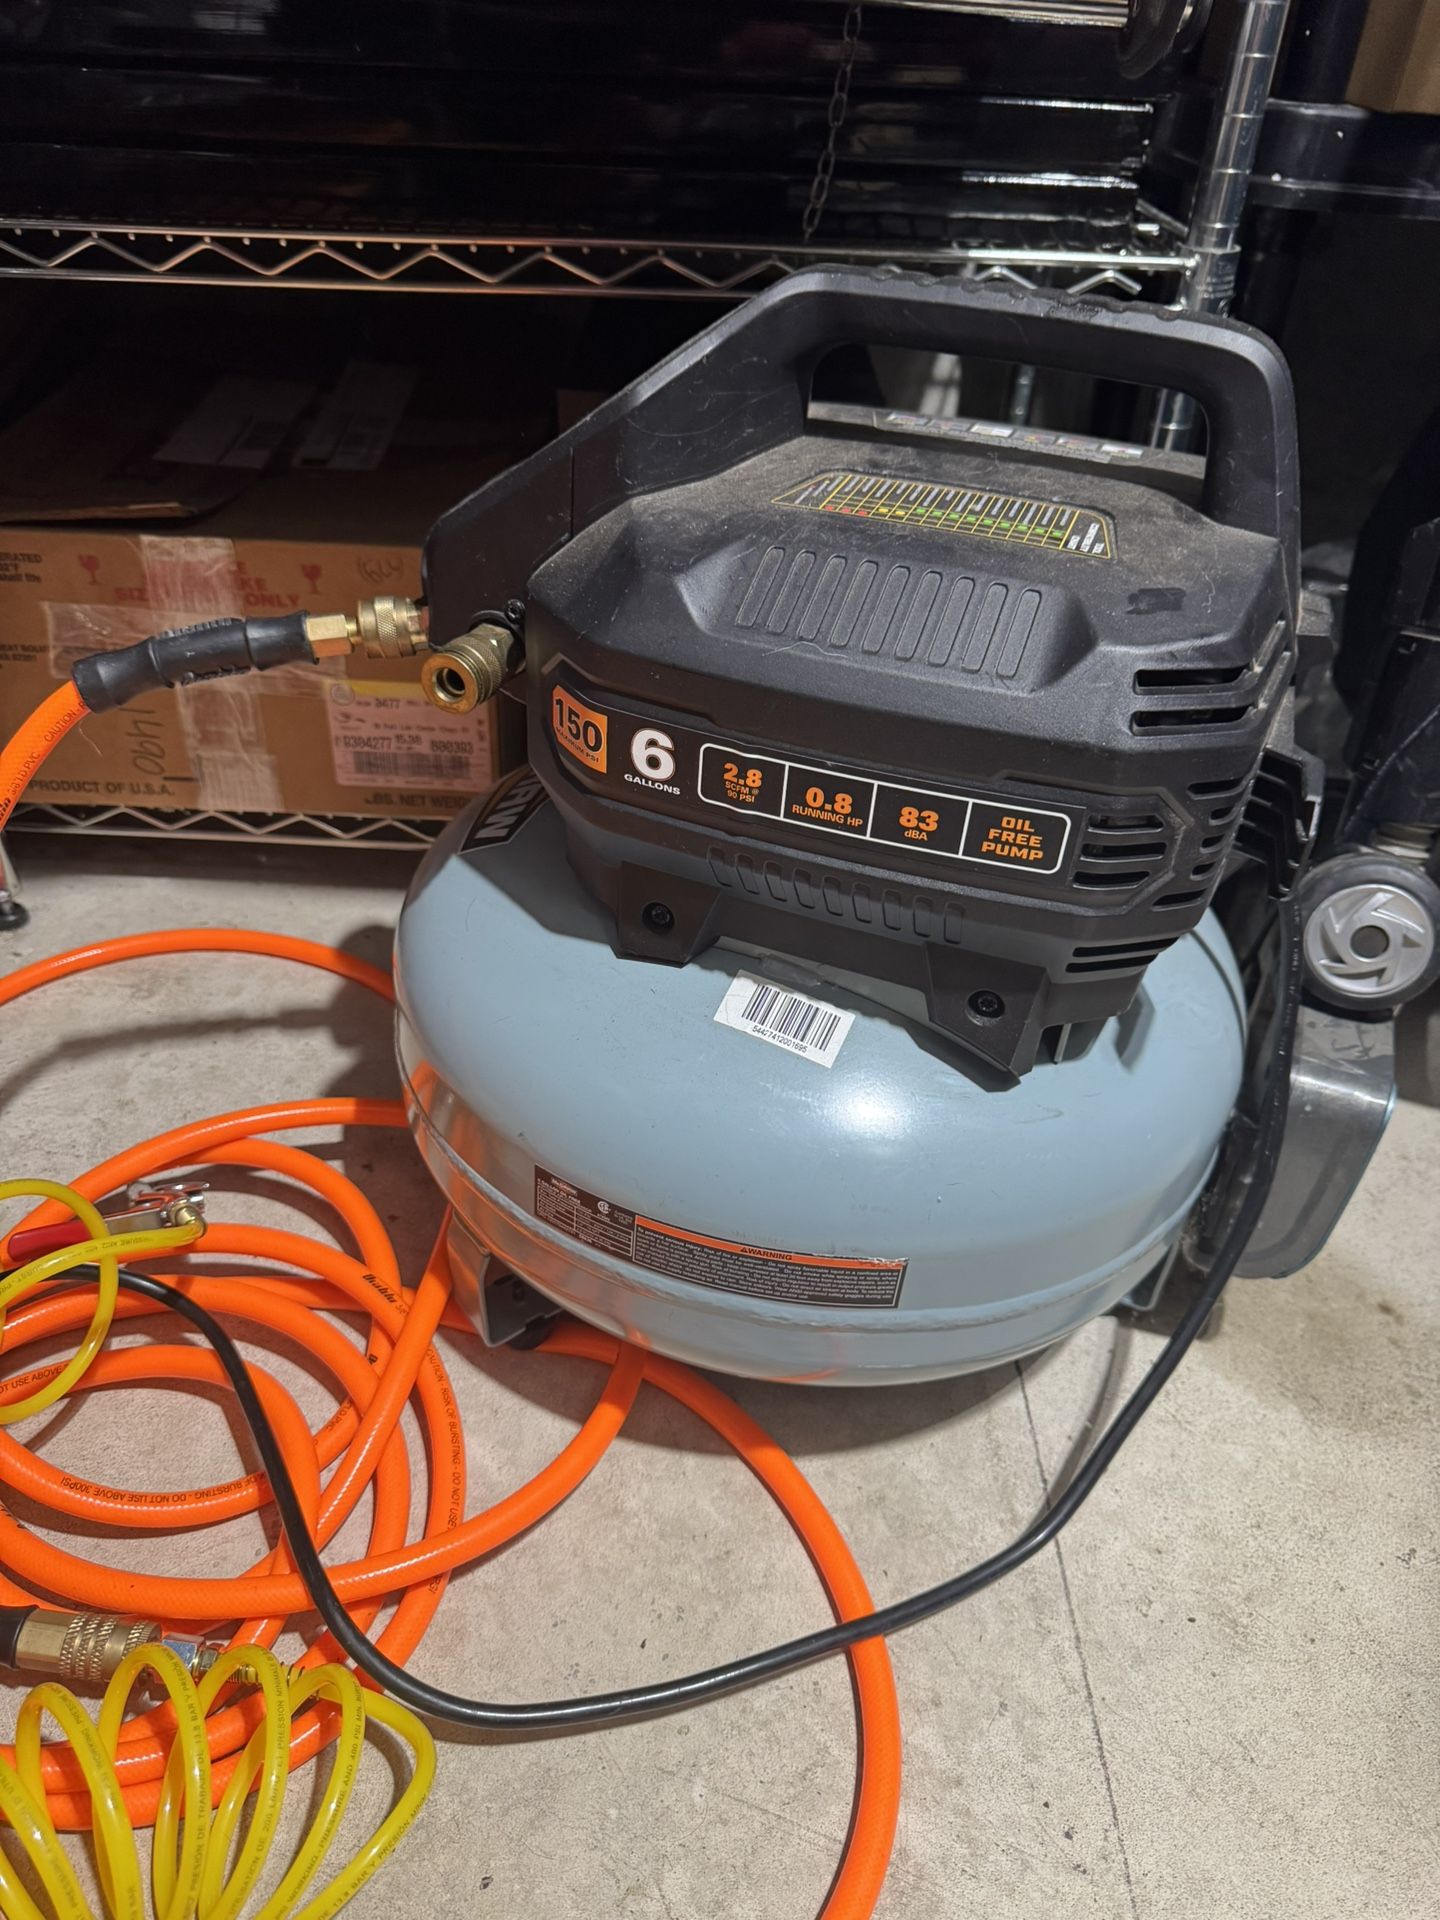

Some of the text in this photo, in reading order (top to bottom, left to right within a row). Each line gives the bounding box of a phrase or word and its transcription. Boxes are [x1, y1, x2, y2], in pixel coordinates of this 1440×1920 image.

[245, 593, 300, 607] ONLY
[43, 707, 77, 744] CAUTION
[555, 698, 603, 753] 150
[631, 727, 676, 782] 6
[624, 773, 680, 796] GALLONS
[723, 762, 763, 788] 2.8
[30, 779, 175, 796] PRODUCT OF U.S.A.
[725, 781, 749, 794] SCFM
[727, 789, 755, 803] 90 PSI
[805, 786, 853, 815] 0.8
[792, 804, 864, 828] RUNNING HP
[899, 806, 939, 832] 83
[1001, 816, 1035, 833] OIL
[904, 829, 928, 841] dBA
[988, 828, 1043, 848] FREE
[981, 841, 1044, 861] PUMP
[747, 1248, 793, 1260] WARNING
[424, 1346, 445, 1383] CAUTION
[12, 1376, 30, 1388] USE
[32, 1366, 63, 1382] ABOVE
[440, 1387, 452, 1407] RISK
[445, 1406, 457, 1420] OF
[448, 1420, 462, 1465] BURSTING
[61, 1476, 92, 1494] 300PSI
[451, 1470, 461, 1486] DO
[93, 1487, 126, 1502] ABOVE
[127, 1494, 147, 1503] USE
[149, 1495, 170, 1503] NOT
[172, 1494, 186, 1502] DO
[194, 1481, 243, 1500] BURSTING
[451, 1487, 460, 1506] NOT
[448, 1508, 458, 1528] USE
[187, 1702, 200, 1722] BAR
[276, 1700, 285, 1750] PRESSION
[341, 1763, 355, 1787] AND
[350, 1869, 370, 1890] BAR
